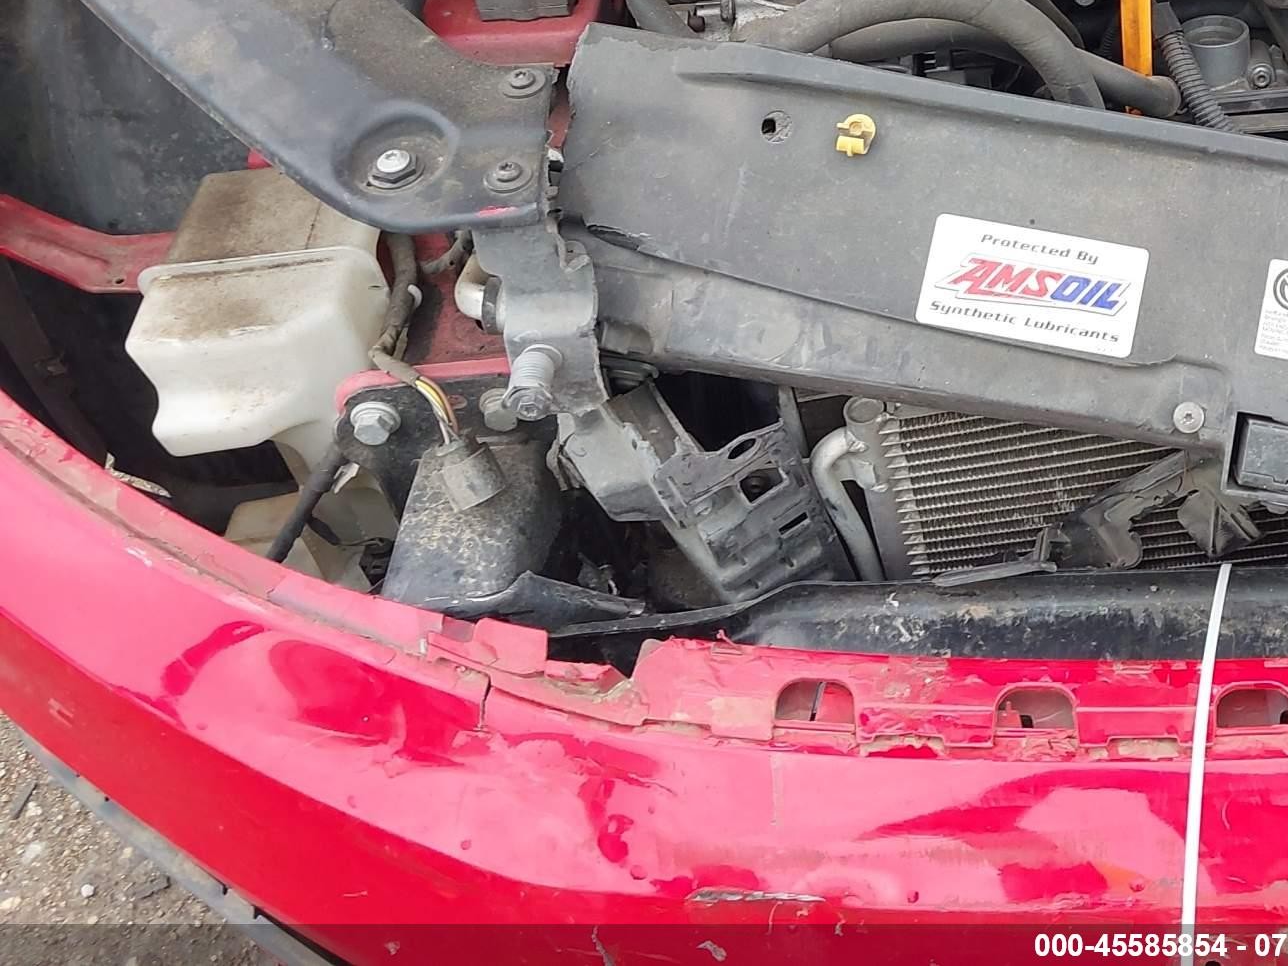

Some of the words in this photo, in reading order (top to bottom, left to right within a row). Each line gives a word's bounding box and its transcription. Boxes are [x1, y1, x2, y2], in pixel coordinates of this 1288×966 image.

[981, 234, 1071, 259] Protected
[1075, 250, 1099, 265] By
[948, 257, 1122, 310] AMSOIL
[929, 300, 1016, 324] Synthetic
[1024, 317, 1119, 343] Lubricants
